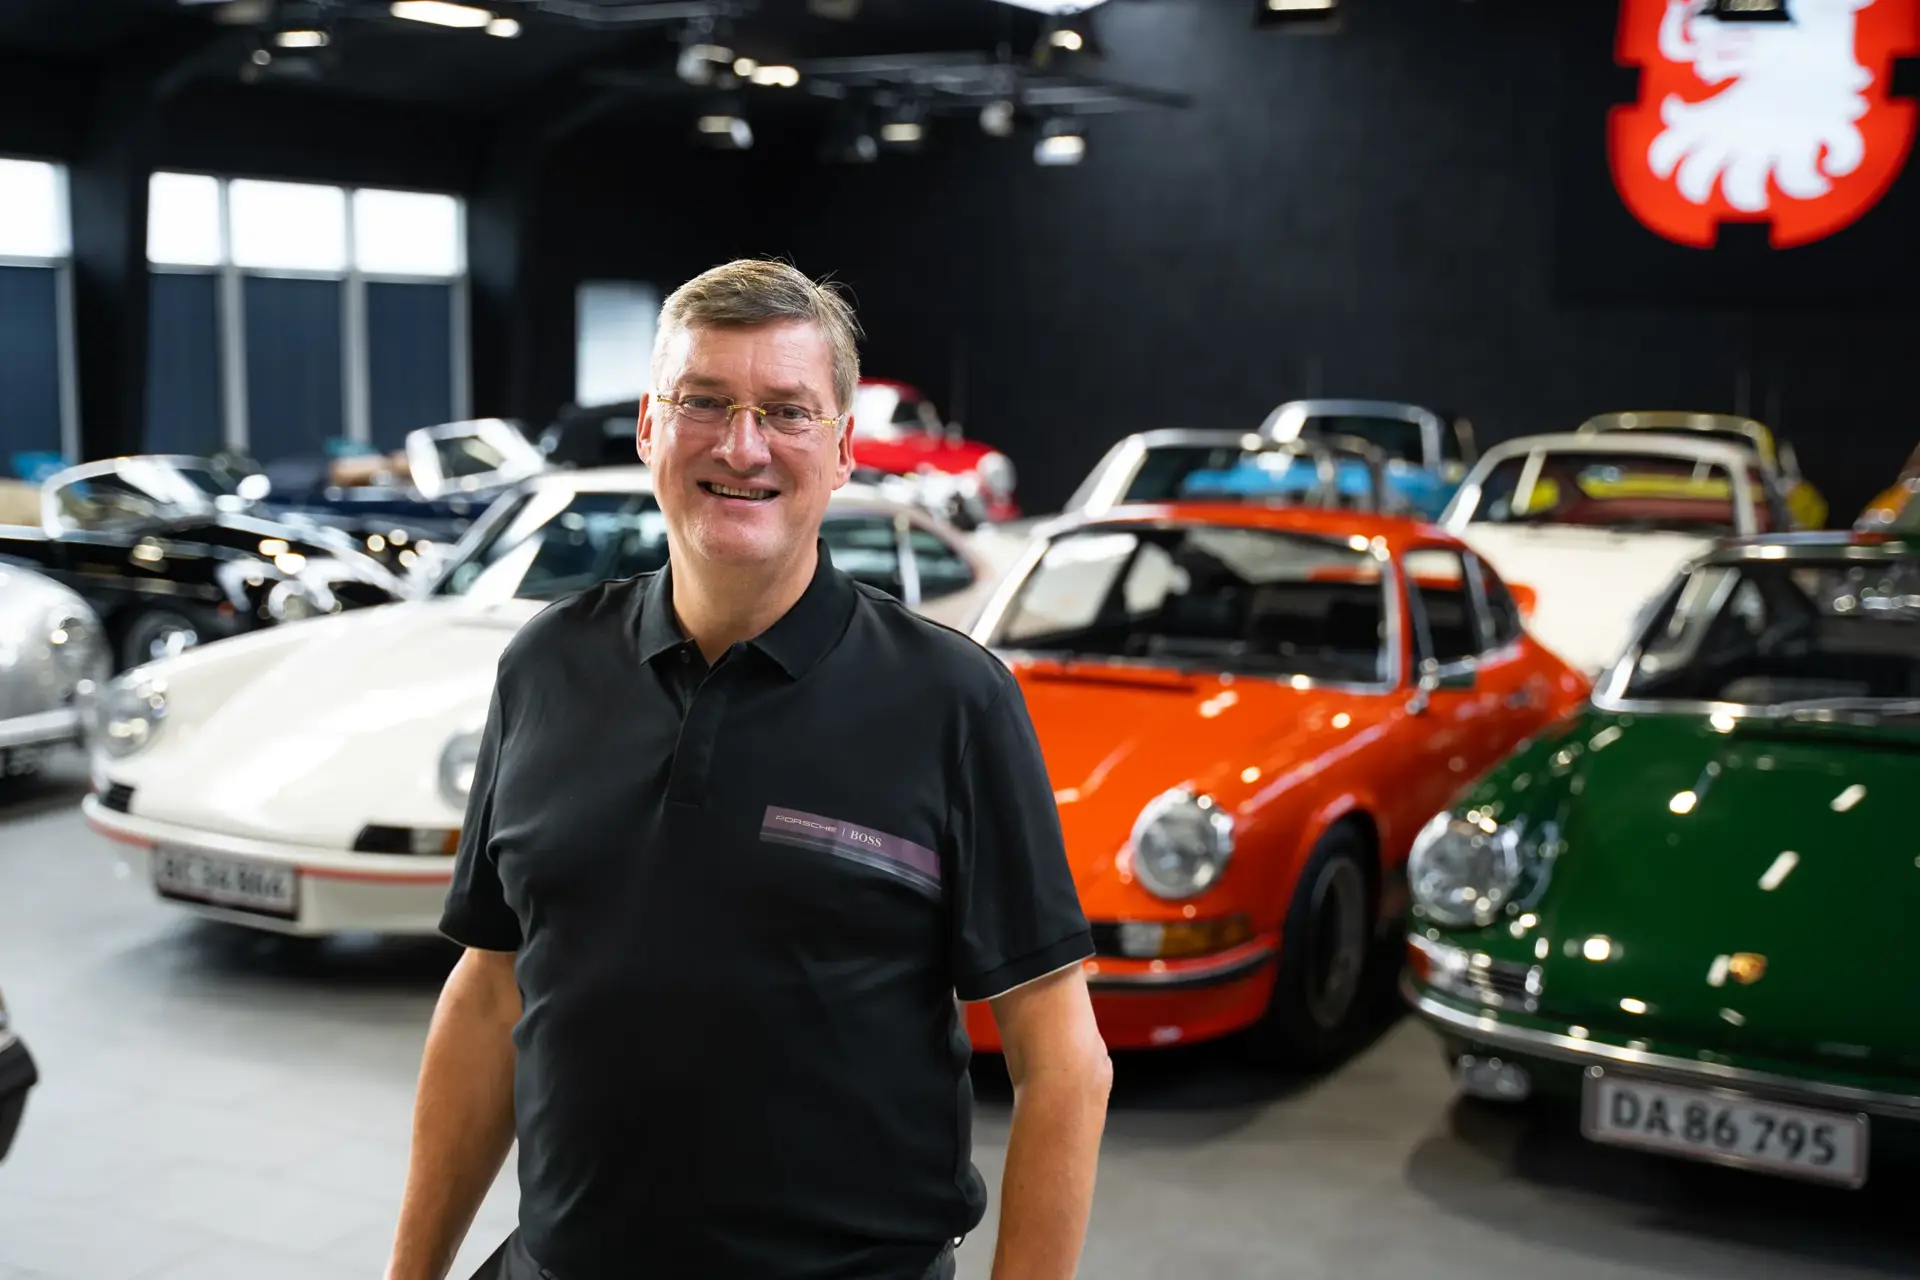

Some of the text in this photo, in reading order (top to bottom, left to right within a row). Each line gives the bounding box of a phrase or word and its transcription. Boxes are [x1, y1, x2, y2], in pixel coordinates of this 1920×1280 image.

[775, 815, 882, 847] PORSCHE BOSS
[1610, 1089, 1838, 1166] DA 86 795
